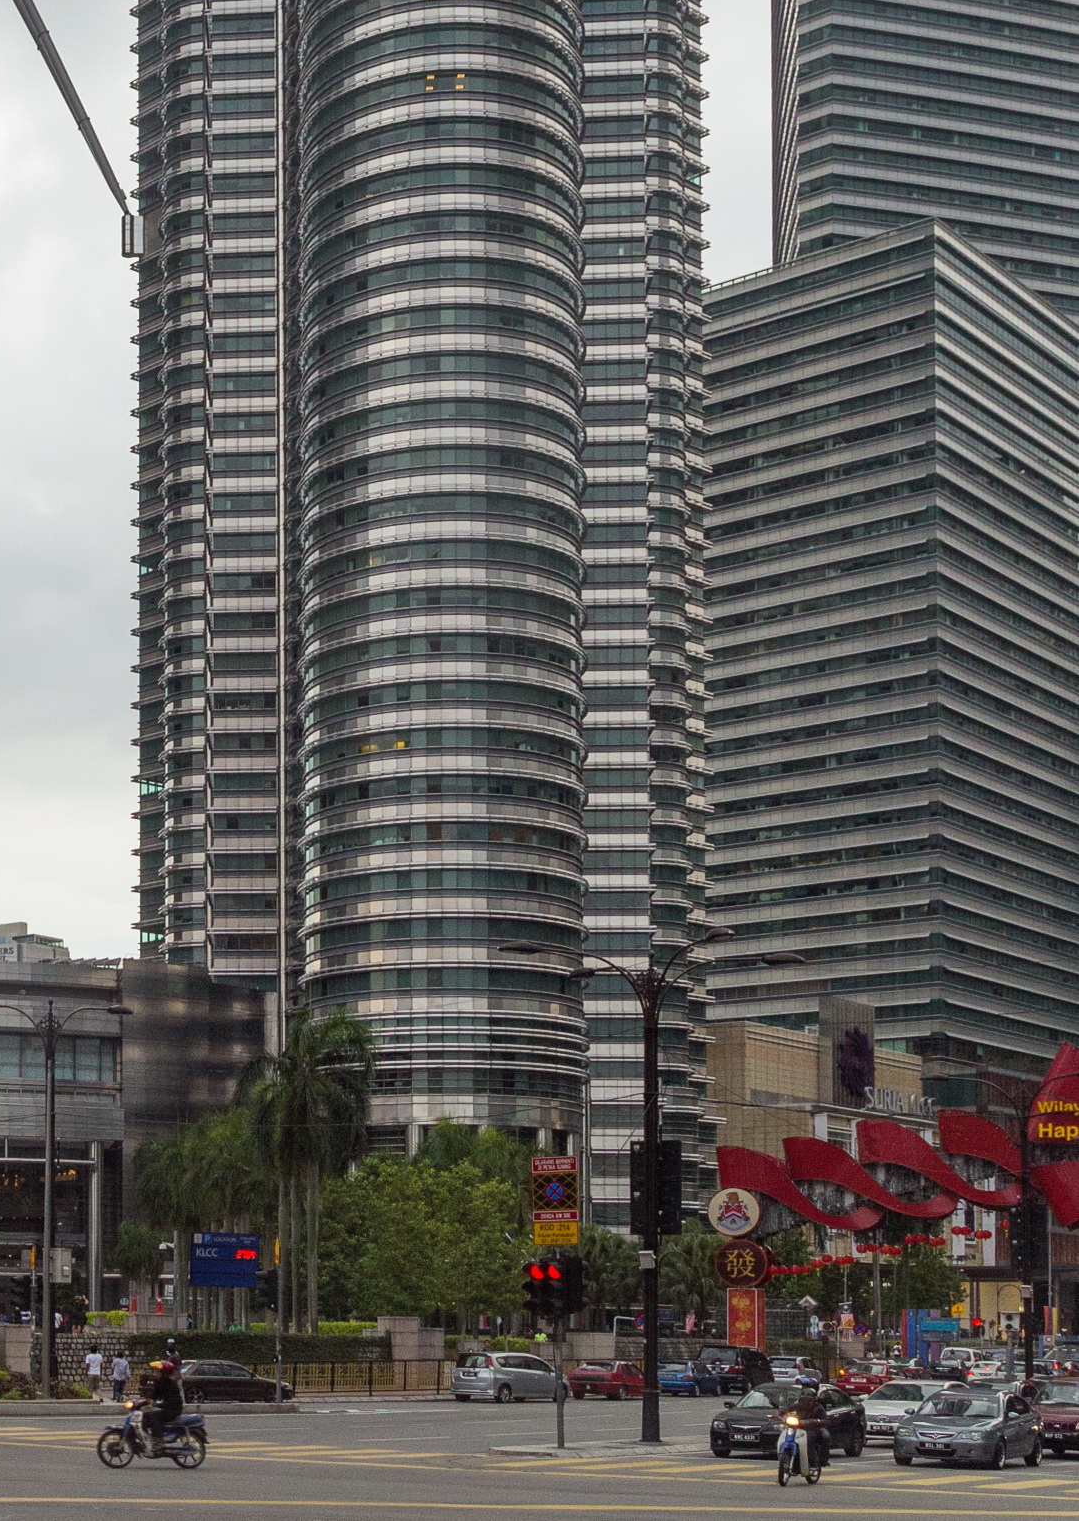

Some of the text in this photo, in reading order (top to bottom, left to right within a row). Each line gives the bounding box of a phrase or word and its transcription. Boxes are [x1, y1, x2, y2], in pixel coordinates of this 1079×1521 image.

[1038, 1122, 1079, 1141] Hap
[196, 1248, 219, 1258] KLCC
[725, 1249, 755, 1278] 發
